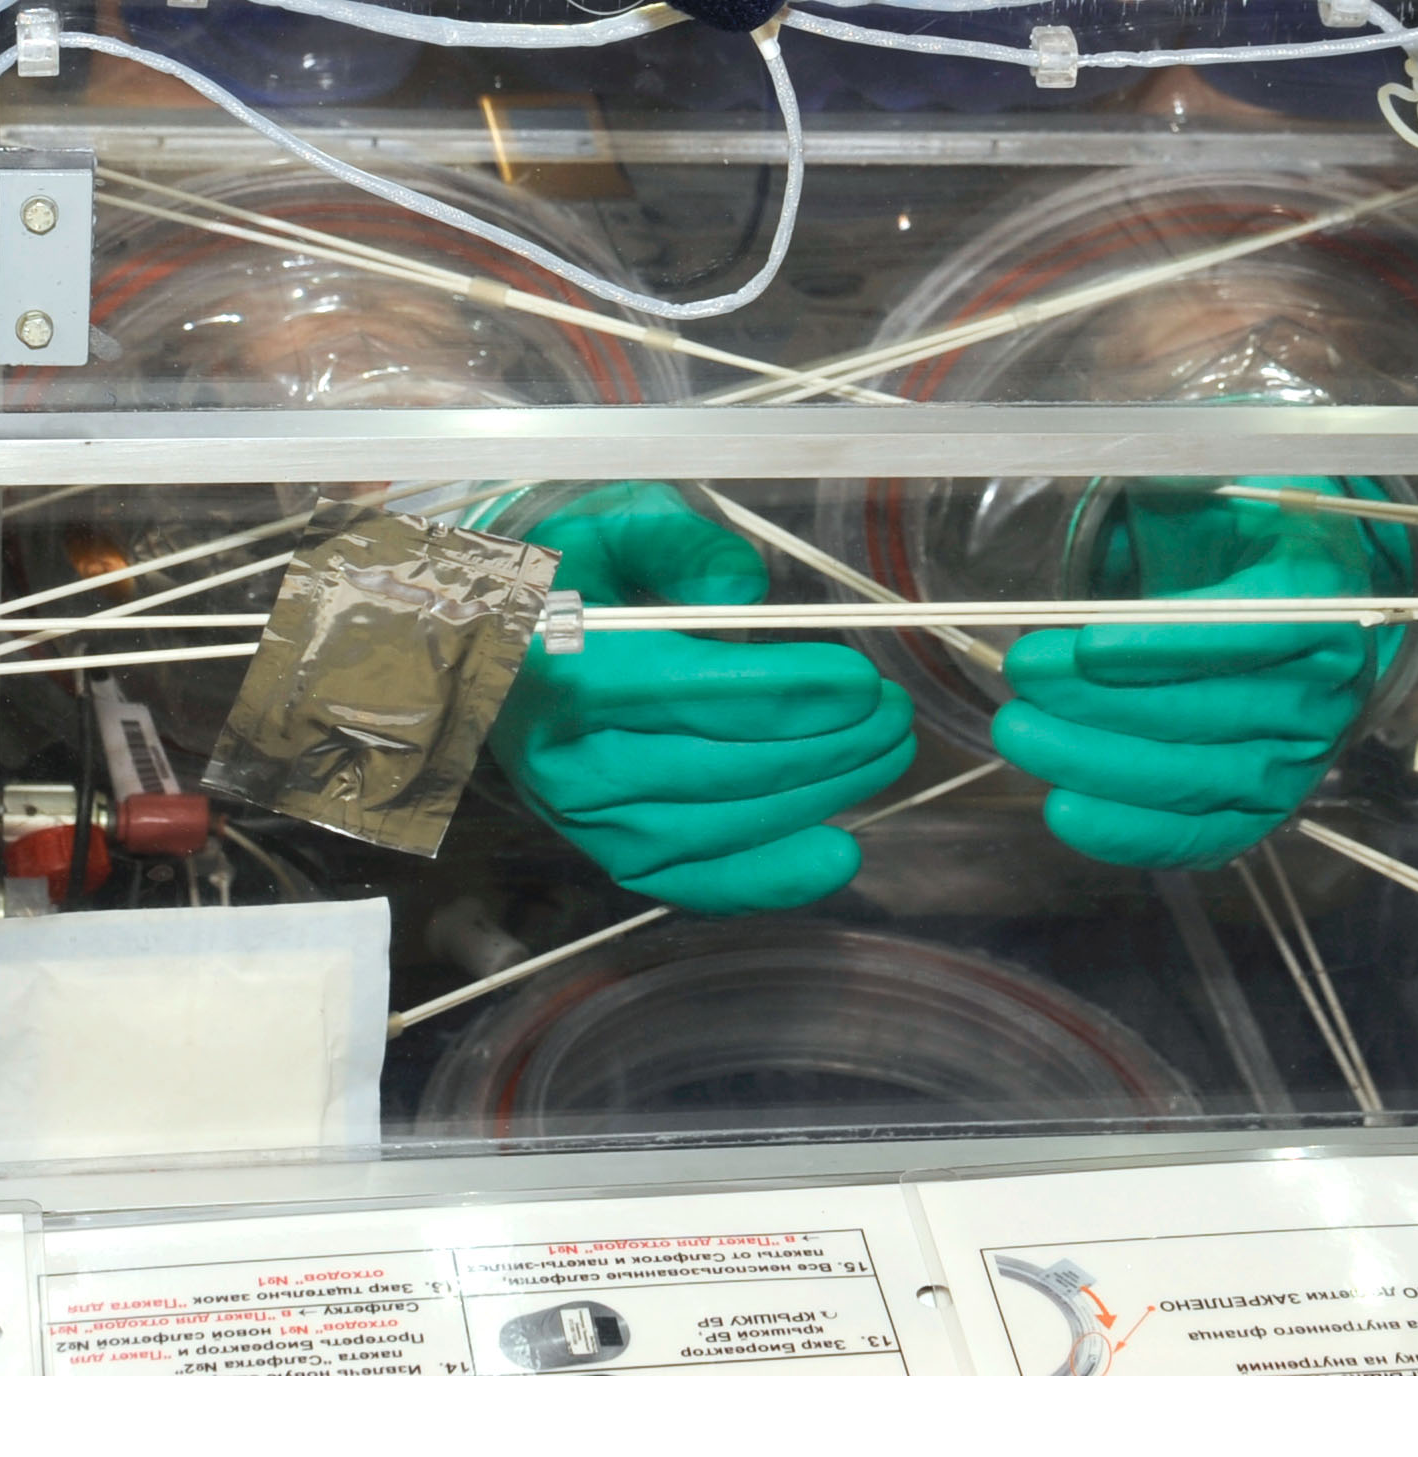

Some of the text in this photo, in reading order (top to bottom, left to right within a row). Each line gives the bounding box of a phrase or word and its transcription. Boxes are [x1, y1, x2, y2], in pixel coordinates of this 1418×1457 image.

[676, 1237, 711, 1247] для
[632, 1250, 824, 1264] пакеты Салфеток
[607, 1265, 792, 1280] неиспользованные
[798, 1264, 832, 1273] Все
[839, 1262, 868, 1273] 15.
[257, 1287, 363, 1301] тщательно
[369, 1284, 413, 1294] Закр
[1306, 1289, 1363, 1303] етки
[194, 1294, 250, 1305] замок
[1160, 1294, 1301, 1312] ЗАКРЕПЛЕНО
[69, 1303, 104, 1313] для
[324, 1300, 419, 1315] Салфетку
[176, 1313, 210, 1325] для
[698, 1313, 816, 1328] КРЫШКУ БР
[212, 1328, 273, 1341] новой
[699, 1325, 824, 1343] крышкой БР,
[1189, 1326, 1267, 1341] фланца
[1274, 1320, 1401, 1336] внутреннего
[97, 1332, 206, 1349] салфеткой
[681, 1336, 893, 1357] 13. Закр Биореактор
[71, 1332, 424, 1364] Протереть Биореактор для
[339, 1351, 403, 1361] пакета
[337, 1365, 422, 1376] Извлечь
[441, 1363, 469, 1375] 14.
[1237, 1356, 1358, 1375] внутренний
